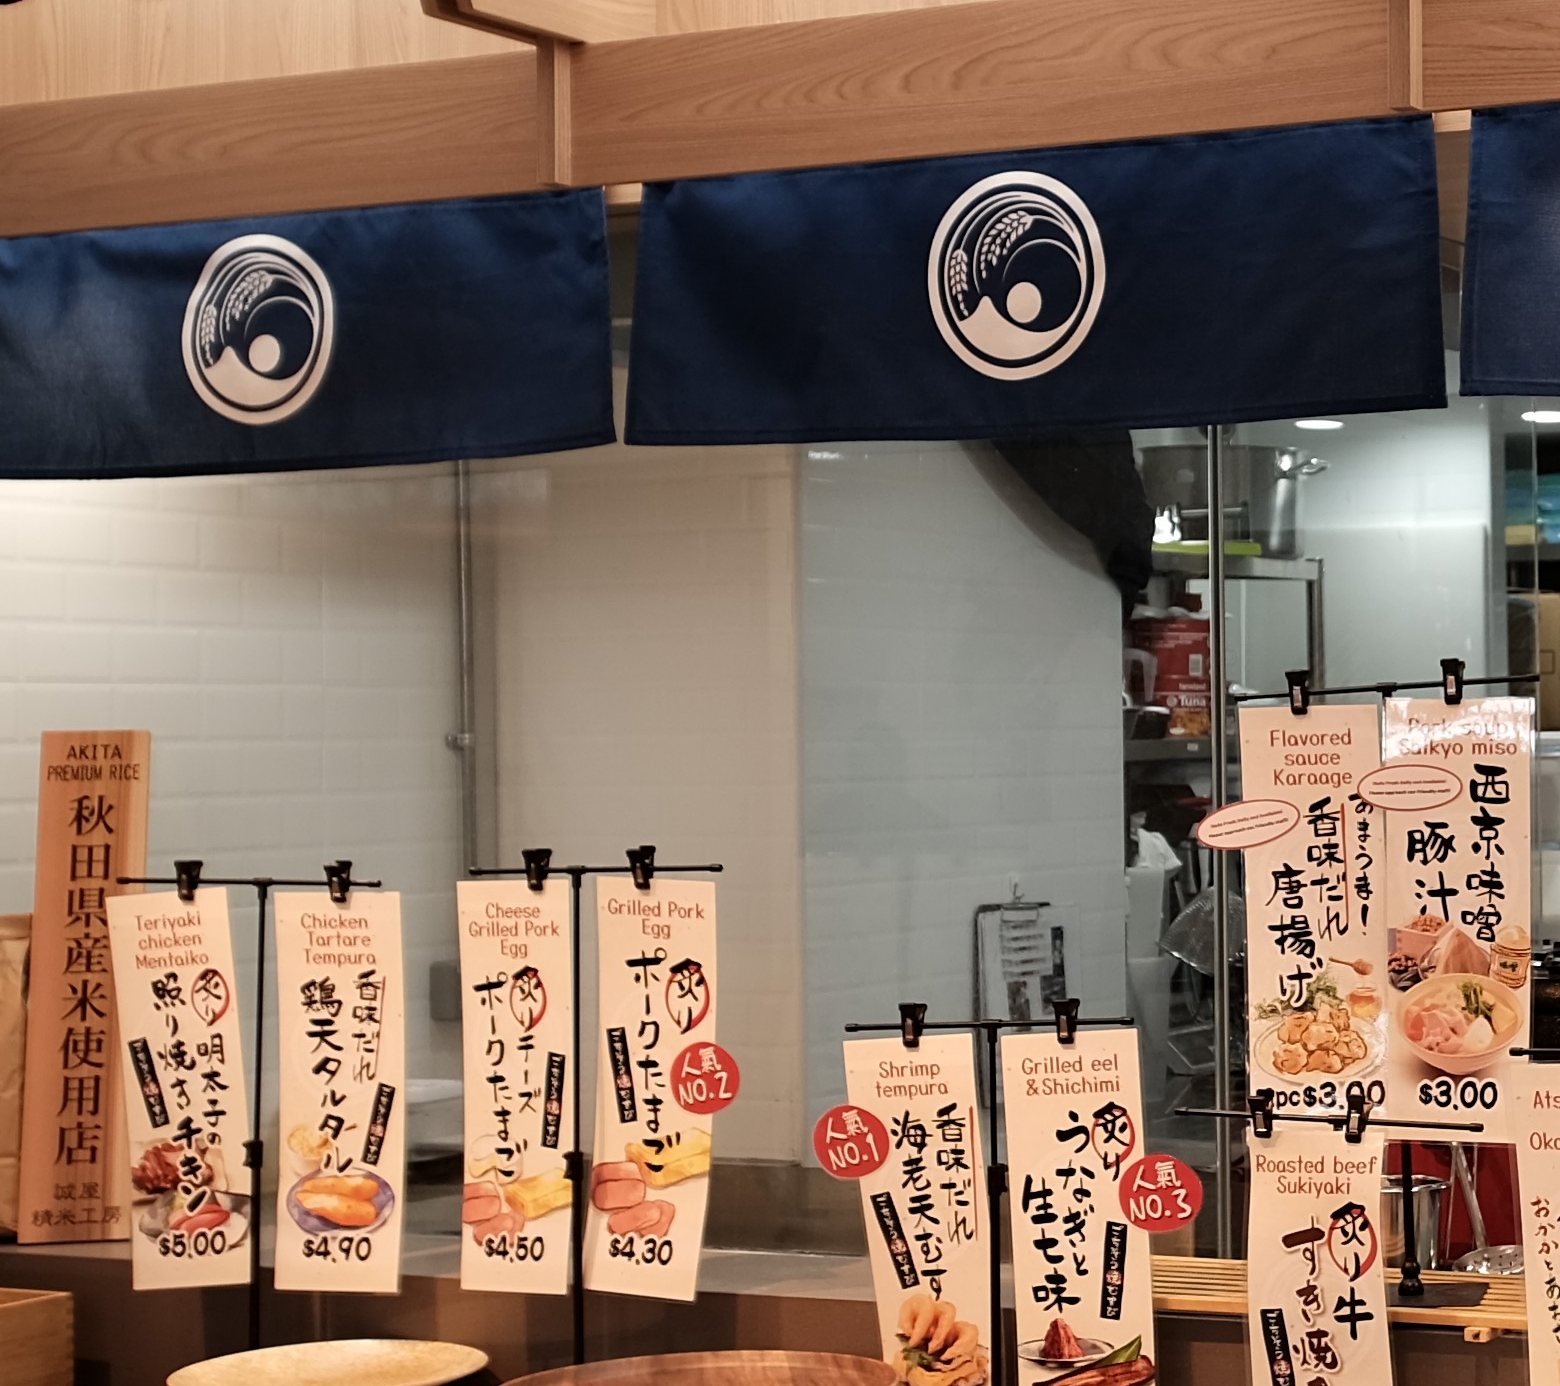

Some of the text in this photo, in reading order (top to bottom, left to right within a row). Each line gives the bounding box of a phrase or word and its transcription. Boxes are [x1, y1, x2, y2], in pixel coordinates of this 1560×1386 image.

[1181, 695, 1206, 707] Tuna
[1270, 729, 1352, 747] Flavored
[1472, 739, 1517, 755] miso
[67, 743, 122, 760] AKITA
[1284, 752, 1340, 766] sauce
[48, 763, 140, 782] PREMIUM RICE
[1273, 769, 1352, 788] Karaage
[1461, 764, 1510, 943] 西京味噌
[1303, 796, 1349, 941] 香味だれ
[1407, 821, 1459, 922] 豚汁
[486, 903, 540, 920] Cheese
[607, 899, 704, 919] Grilled Pork
[136, 911, 201, 932] Teriyaki
[300, 913, 368, 931] Chicken
[469, 921, 559, 938] Grilled Pork
[642, 919, 670, 939] Egg
[139, 931, 202, 951] chicken
[306, 931, 371, 947] Tartare
[1266, 863, 1328, 1007] 唐揚げ
[303, 949, 376, 967] Tempura
[501, 940, 528, 958] Egg
[136, 951, 209, 969] Mentaiko
[54, 794, 115, 1165] 秋田県産米使用店
[352, 969, 380, 1083] 香味だれ
[626, 947, 681, 1172] ポークたまご
[1021, 1054, 1119, 1076] Grilled eel
[473, 972, 527, 1179] ポークたまご
[879, 1061, 940, 1080] Shrimp
[679, 1072, 733, 1106] NO.2
[876, 1080, 948, 1099] tempura
[1418, 1081, 1498, 1111] $3.00
[829, 1134, 879, 1171] NO.1
[932, 1102, 974, 1247] 香味だれ
[1255, 1155, 1377, 1175] Roasted beef
[1056, 1110, 1094, 1276] うなぎと
[1276, 1176, 1351, 1196] Sukiyaki
[890, 1110, 948, 1301] 海老天むす
[1129, 1190, 1192, 1222] NO.3
[159, 1230, 226, 1259] $5.00
[302, 1237, 371, 1263] $4.90
[485, 1237, 545, 1262] $4.50
[609, 1237, 673, 1265] $4.30
[1023, 1173, 1081, 1313] 生七味
